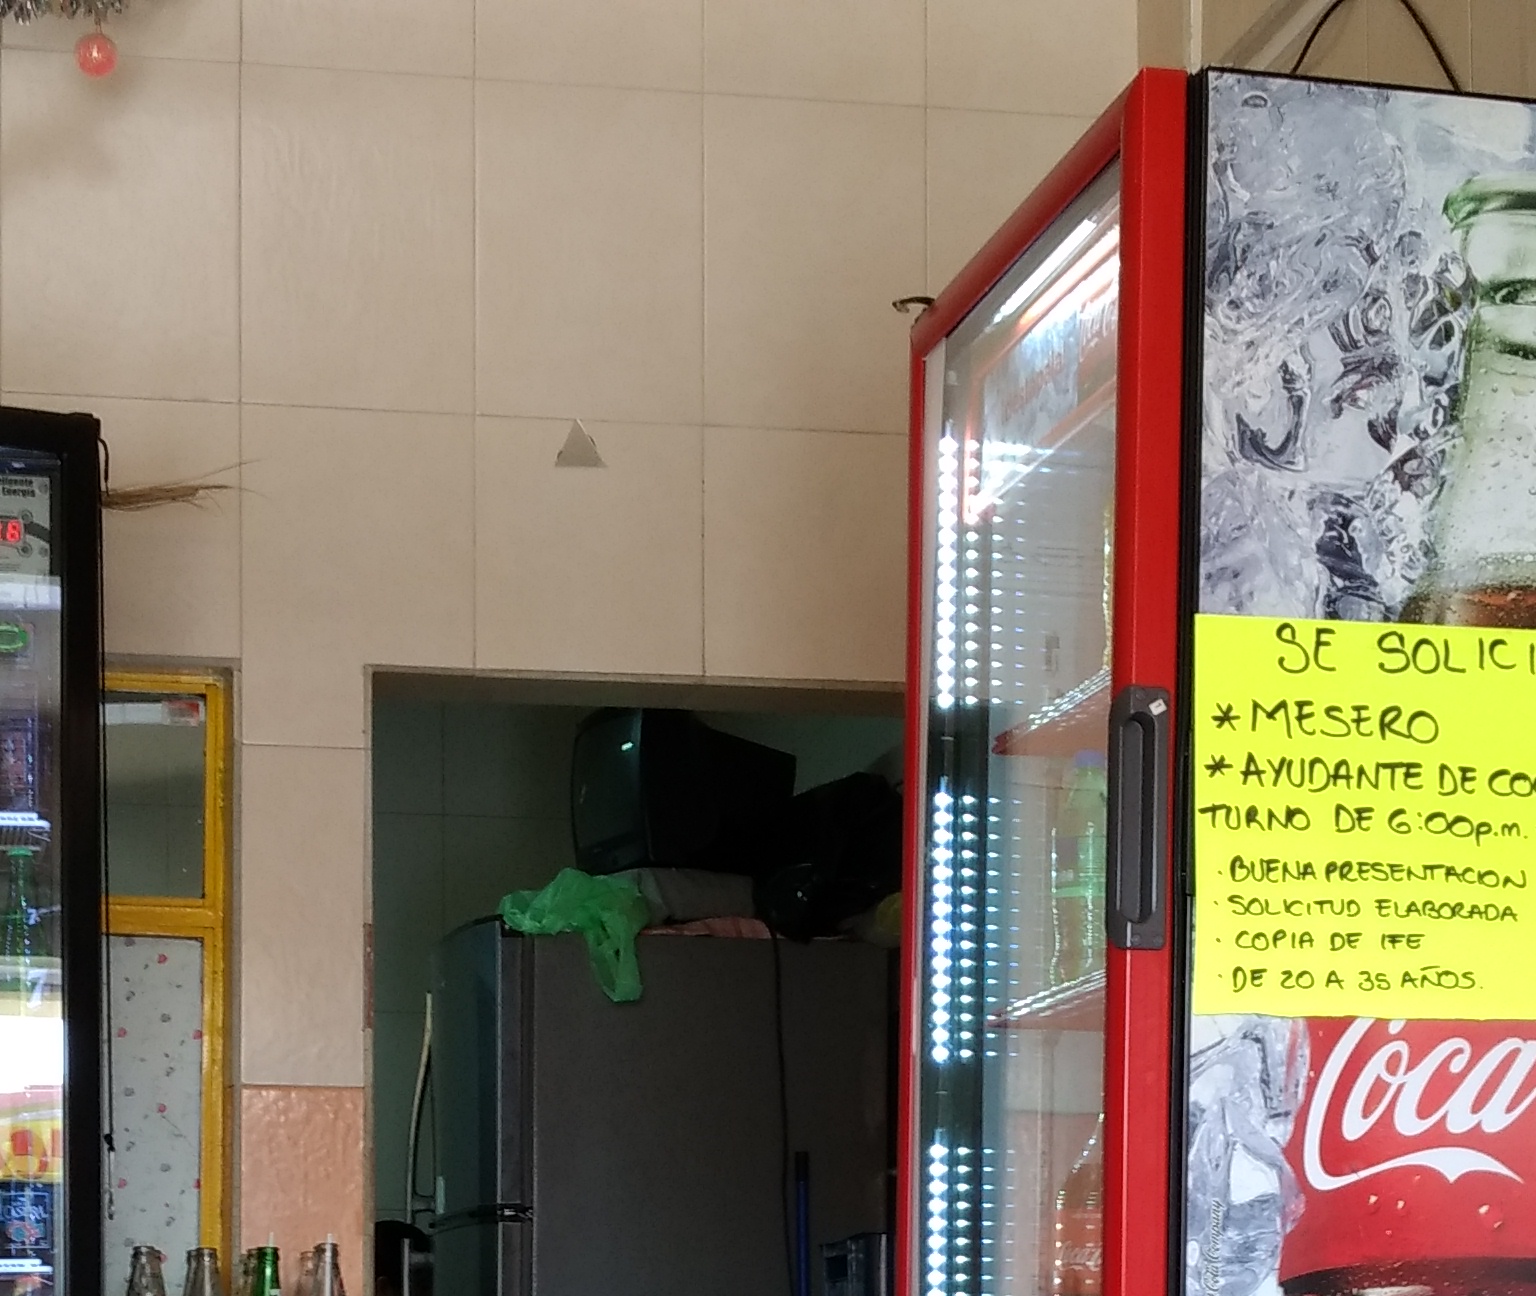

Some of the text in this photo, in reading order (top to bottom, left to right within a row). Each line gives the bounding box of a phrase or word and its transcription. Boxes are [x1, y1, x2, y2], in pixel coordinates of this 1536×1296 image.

[1276, 623, 1336, 673] SE
[1251, 699, 1439, 744] MESERO
[1240, 752, 1423, 793] AYUDANTE
[1438, 763, 1476, 796] DE
[1198, 803, 1311, 832] TURNO
[1335, 803, 1374, 834] DE
[1229, 855, 1528, 889] BUENA PRESENTACION
[1227, 894, 1519, 922] SOLICITUD ELABORADA
[1235, 929, 1426, 951] COPIA DE IFE
[1232, 966, 1268, 992] DE
[1280, 970, 1314, 990] 20
[1325, 970, 1345, 990] A
[1358, 970, 1391, 991] 35
